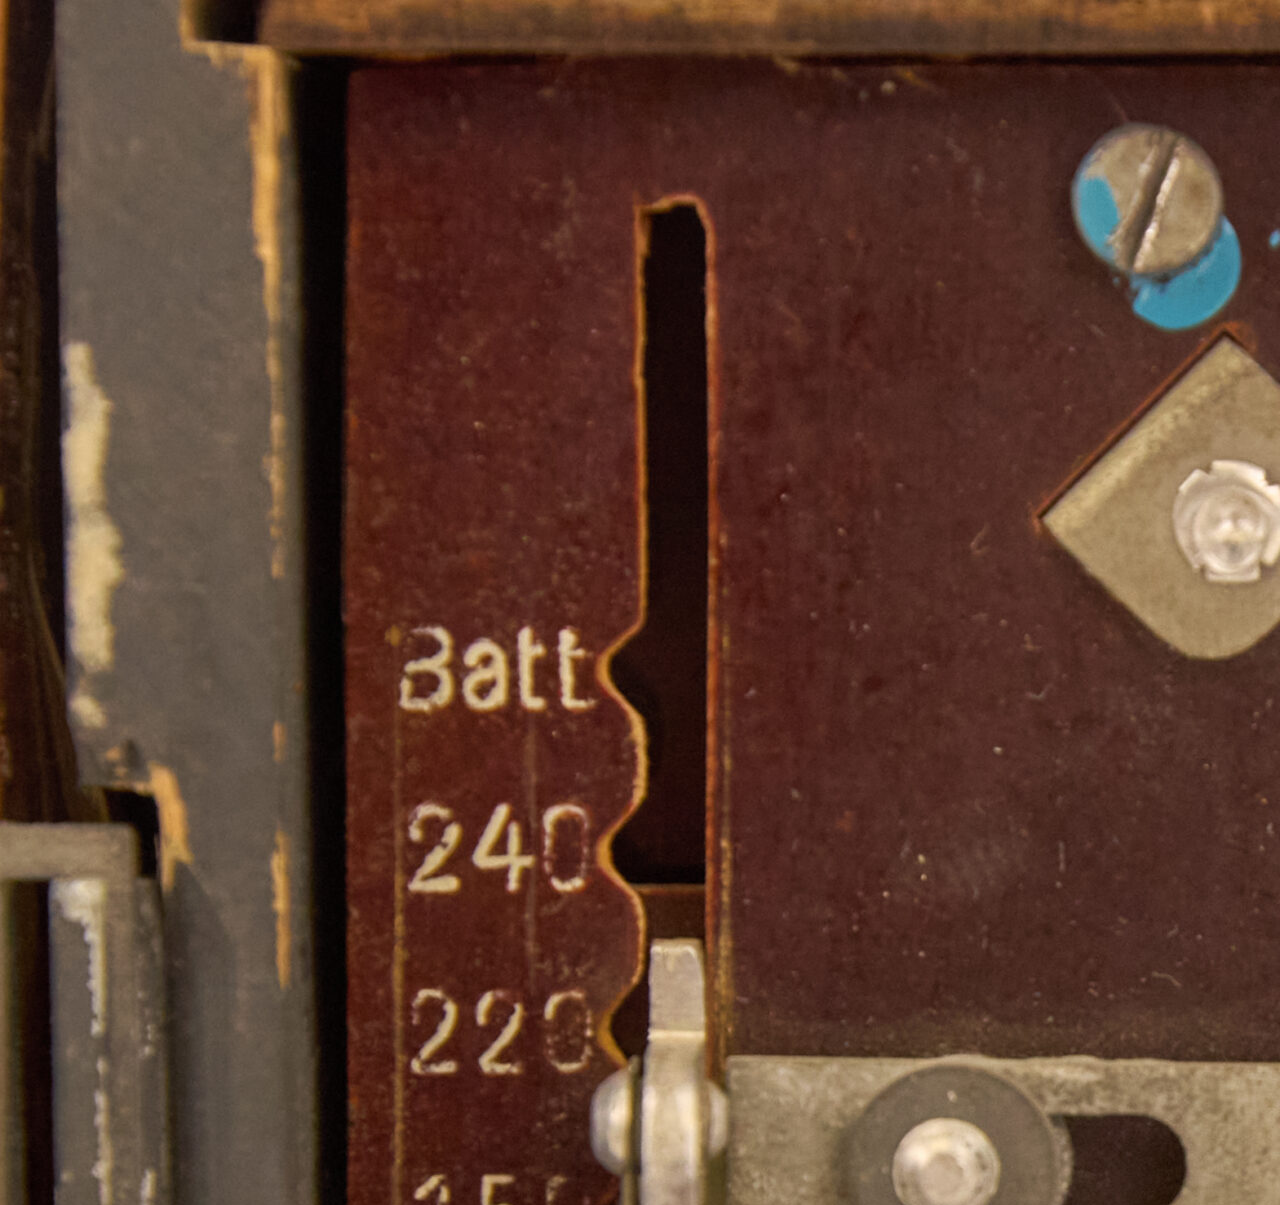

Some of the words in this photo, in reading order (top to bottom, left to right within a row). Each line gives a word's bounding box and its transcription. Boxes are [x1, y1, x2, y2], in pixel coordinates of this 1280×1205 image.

[400, 626, 596, 712] Batt
[408, 803, 592, 892] 240
[411, 989, 593, 1074] 220
